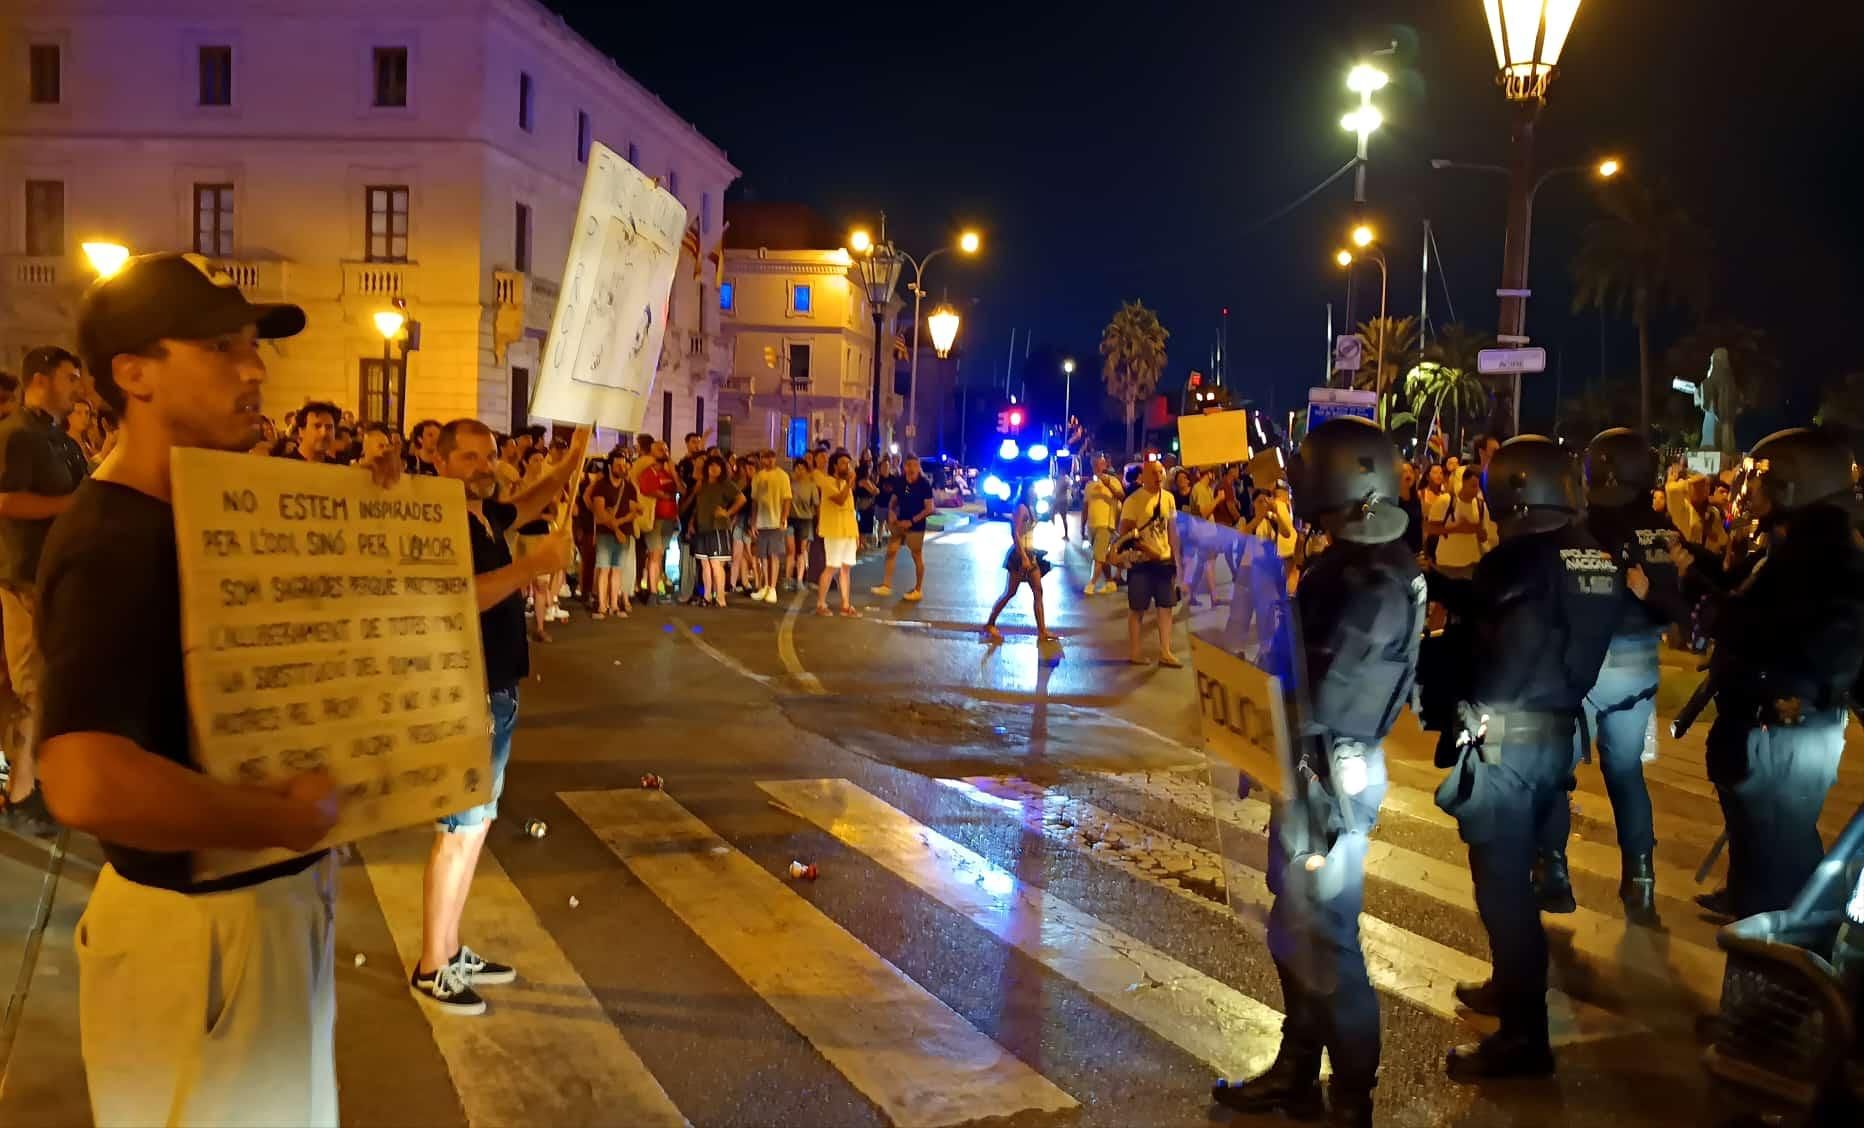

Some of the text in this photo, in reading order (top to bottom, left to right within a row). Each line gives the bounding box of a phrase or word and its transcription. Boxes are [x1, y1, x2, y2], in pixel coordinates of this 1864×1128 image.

[221, 489, 443, 523] NO ESTEM INSPIRADES
[202, 529, 241, 557] PER
[358, 533, 390, 556] PER
